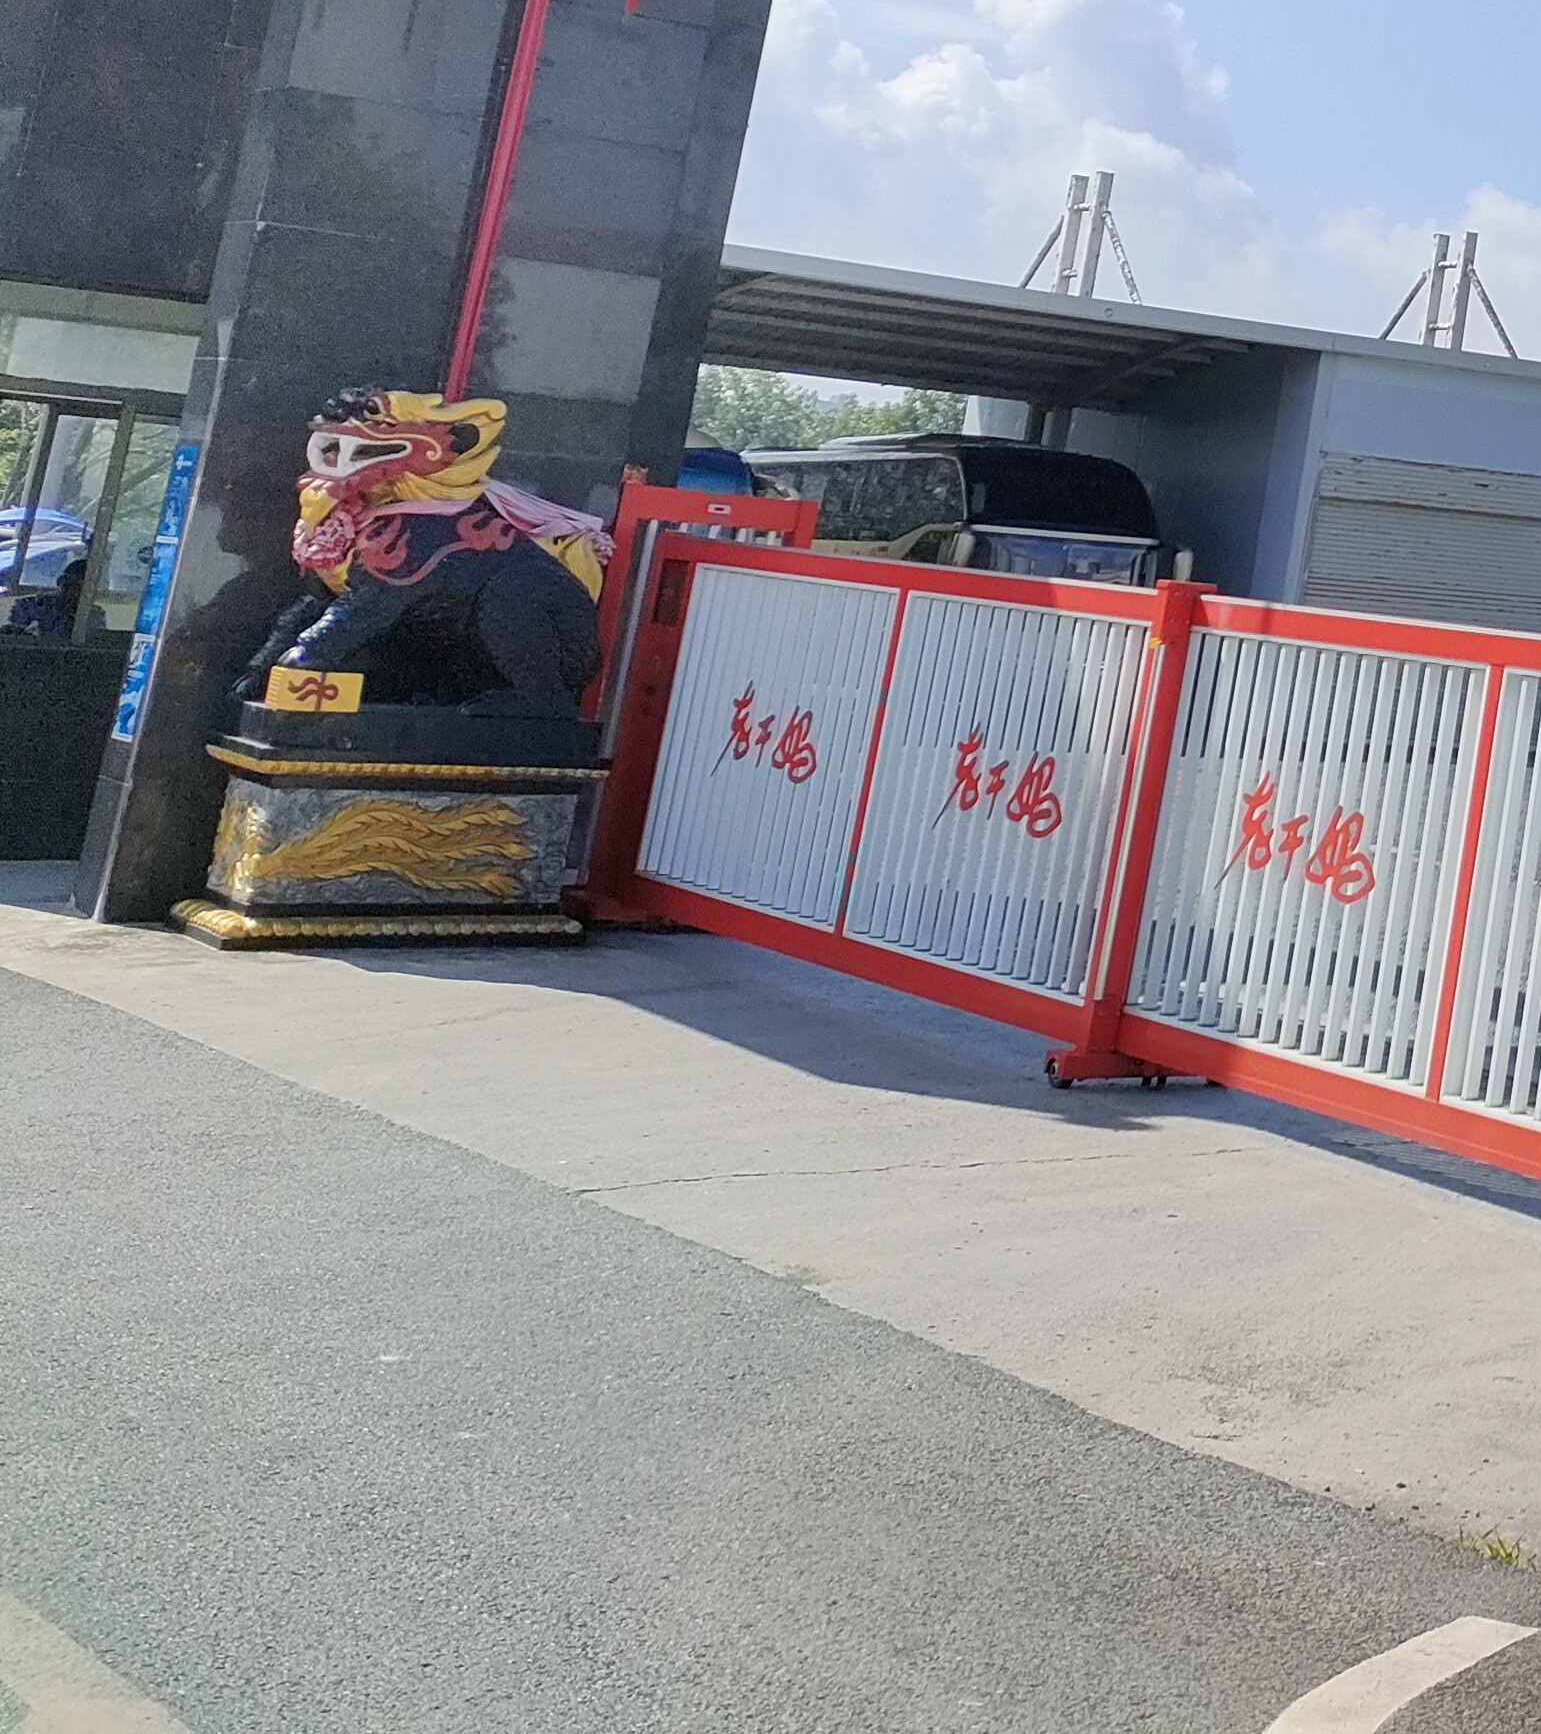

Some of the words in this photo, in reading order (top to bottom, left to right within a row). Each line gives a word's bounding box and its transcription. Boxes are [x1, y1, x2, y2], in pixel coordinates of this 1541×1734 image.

[711, 681, 817, 784] 老干妈
[931, 721, 1062, 839] 老干妈
[1214, 770, 1376, 906] 老干妈
